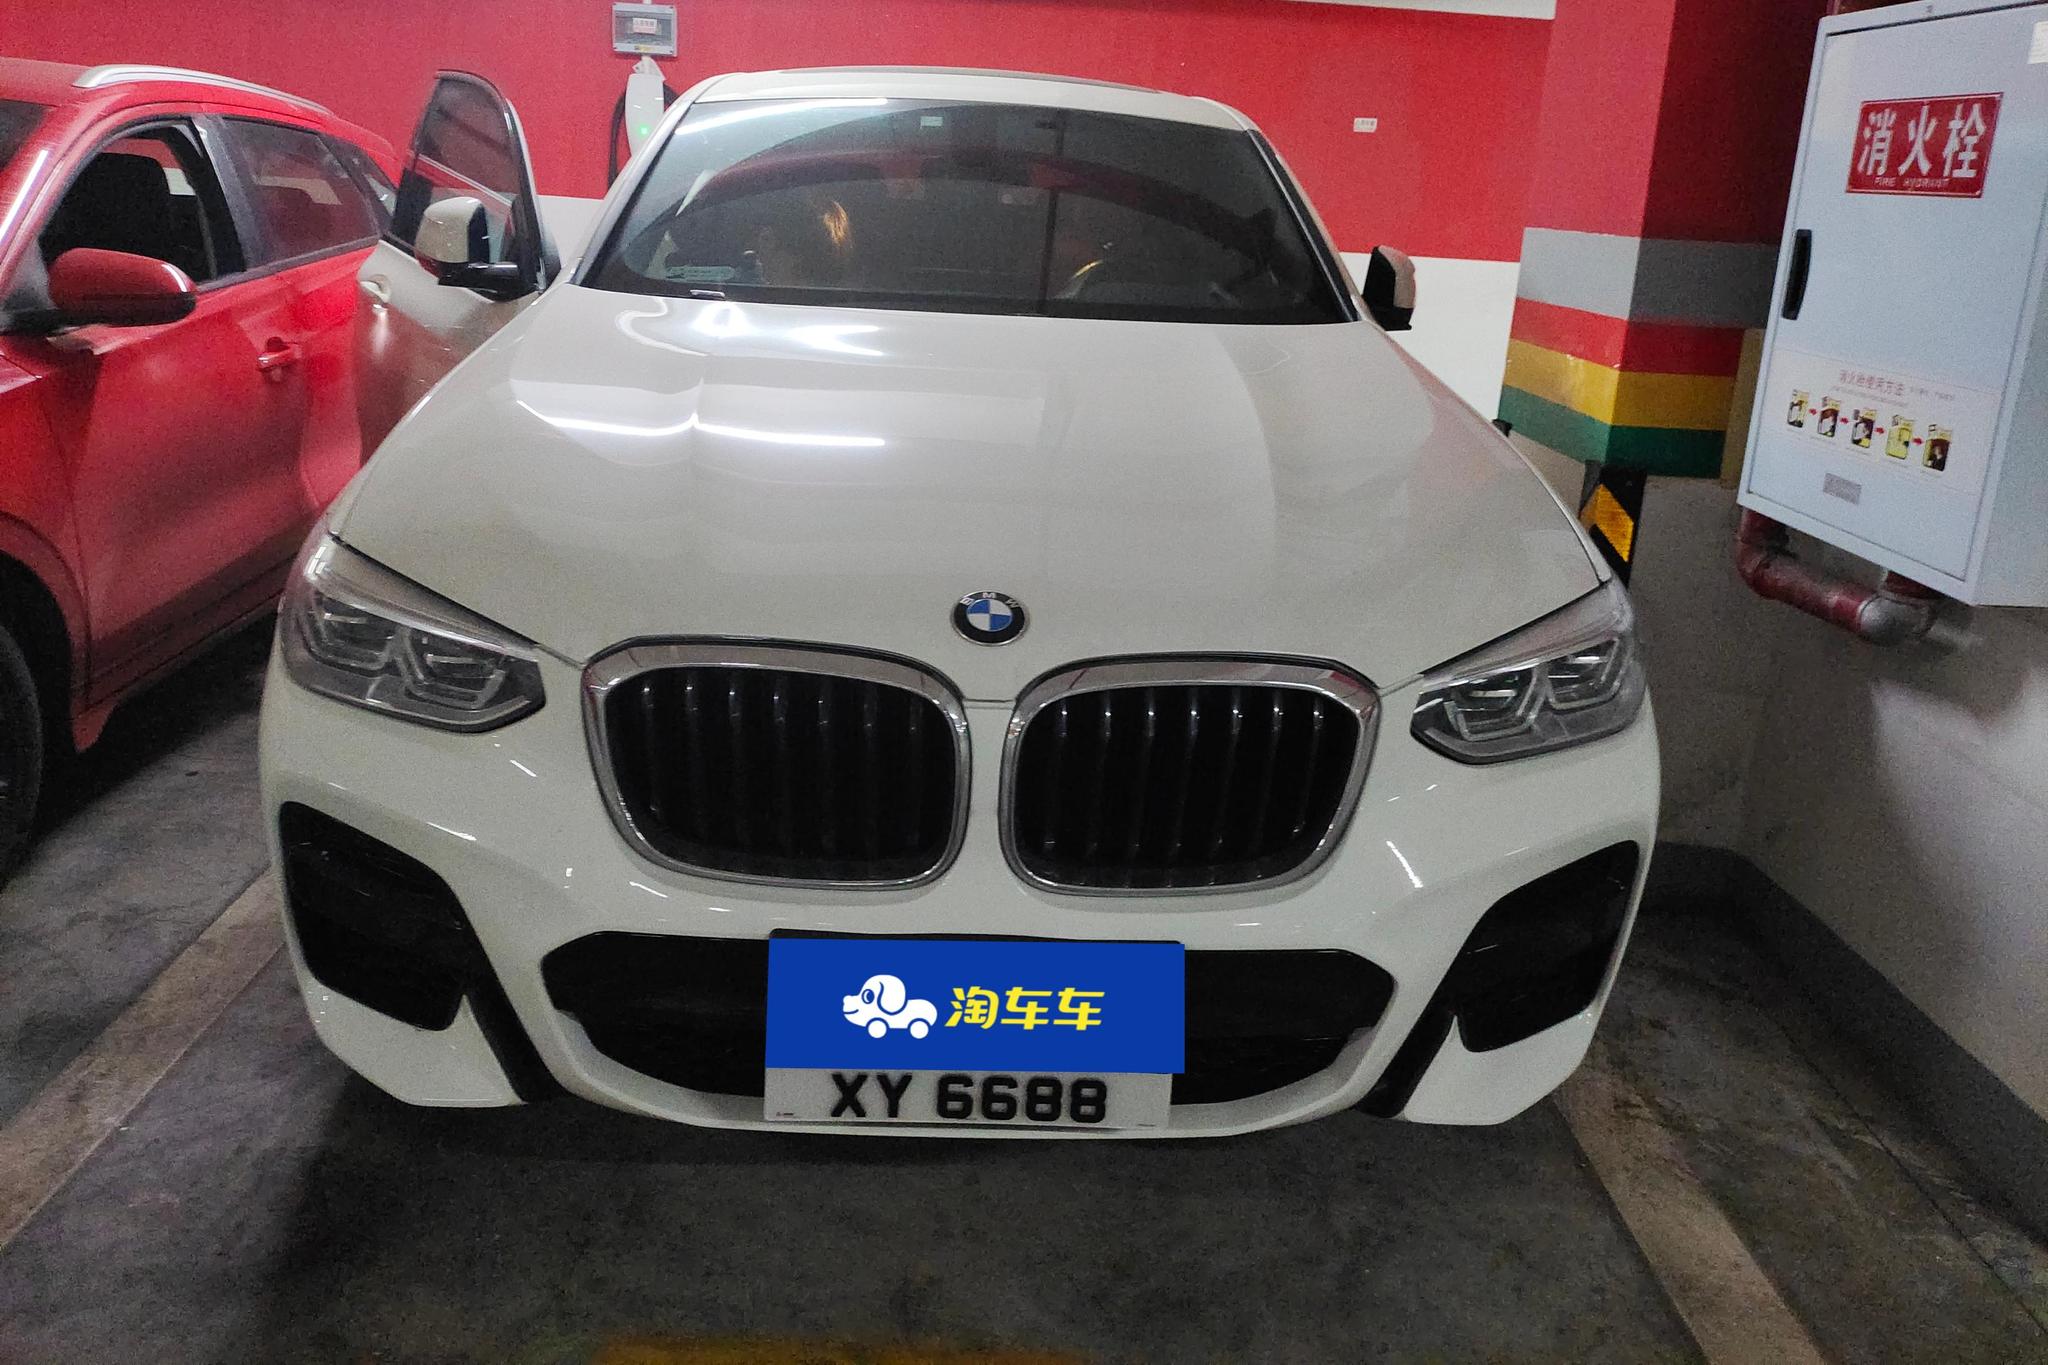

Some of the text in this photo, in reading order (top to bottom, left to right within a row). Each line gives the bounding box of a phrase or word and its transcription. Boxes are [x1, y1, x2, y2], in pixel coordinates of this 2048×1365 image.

[1857, 103, 1986, 178] 消火栓
[960, 592, 1019, 608] BMW
[831, 1073, 1107, 1123] XY 6688
